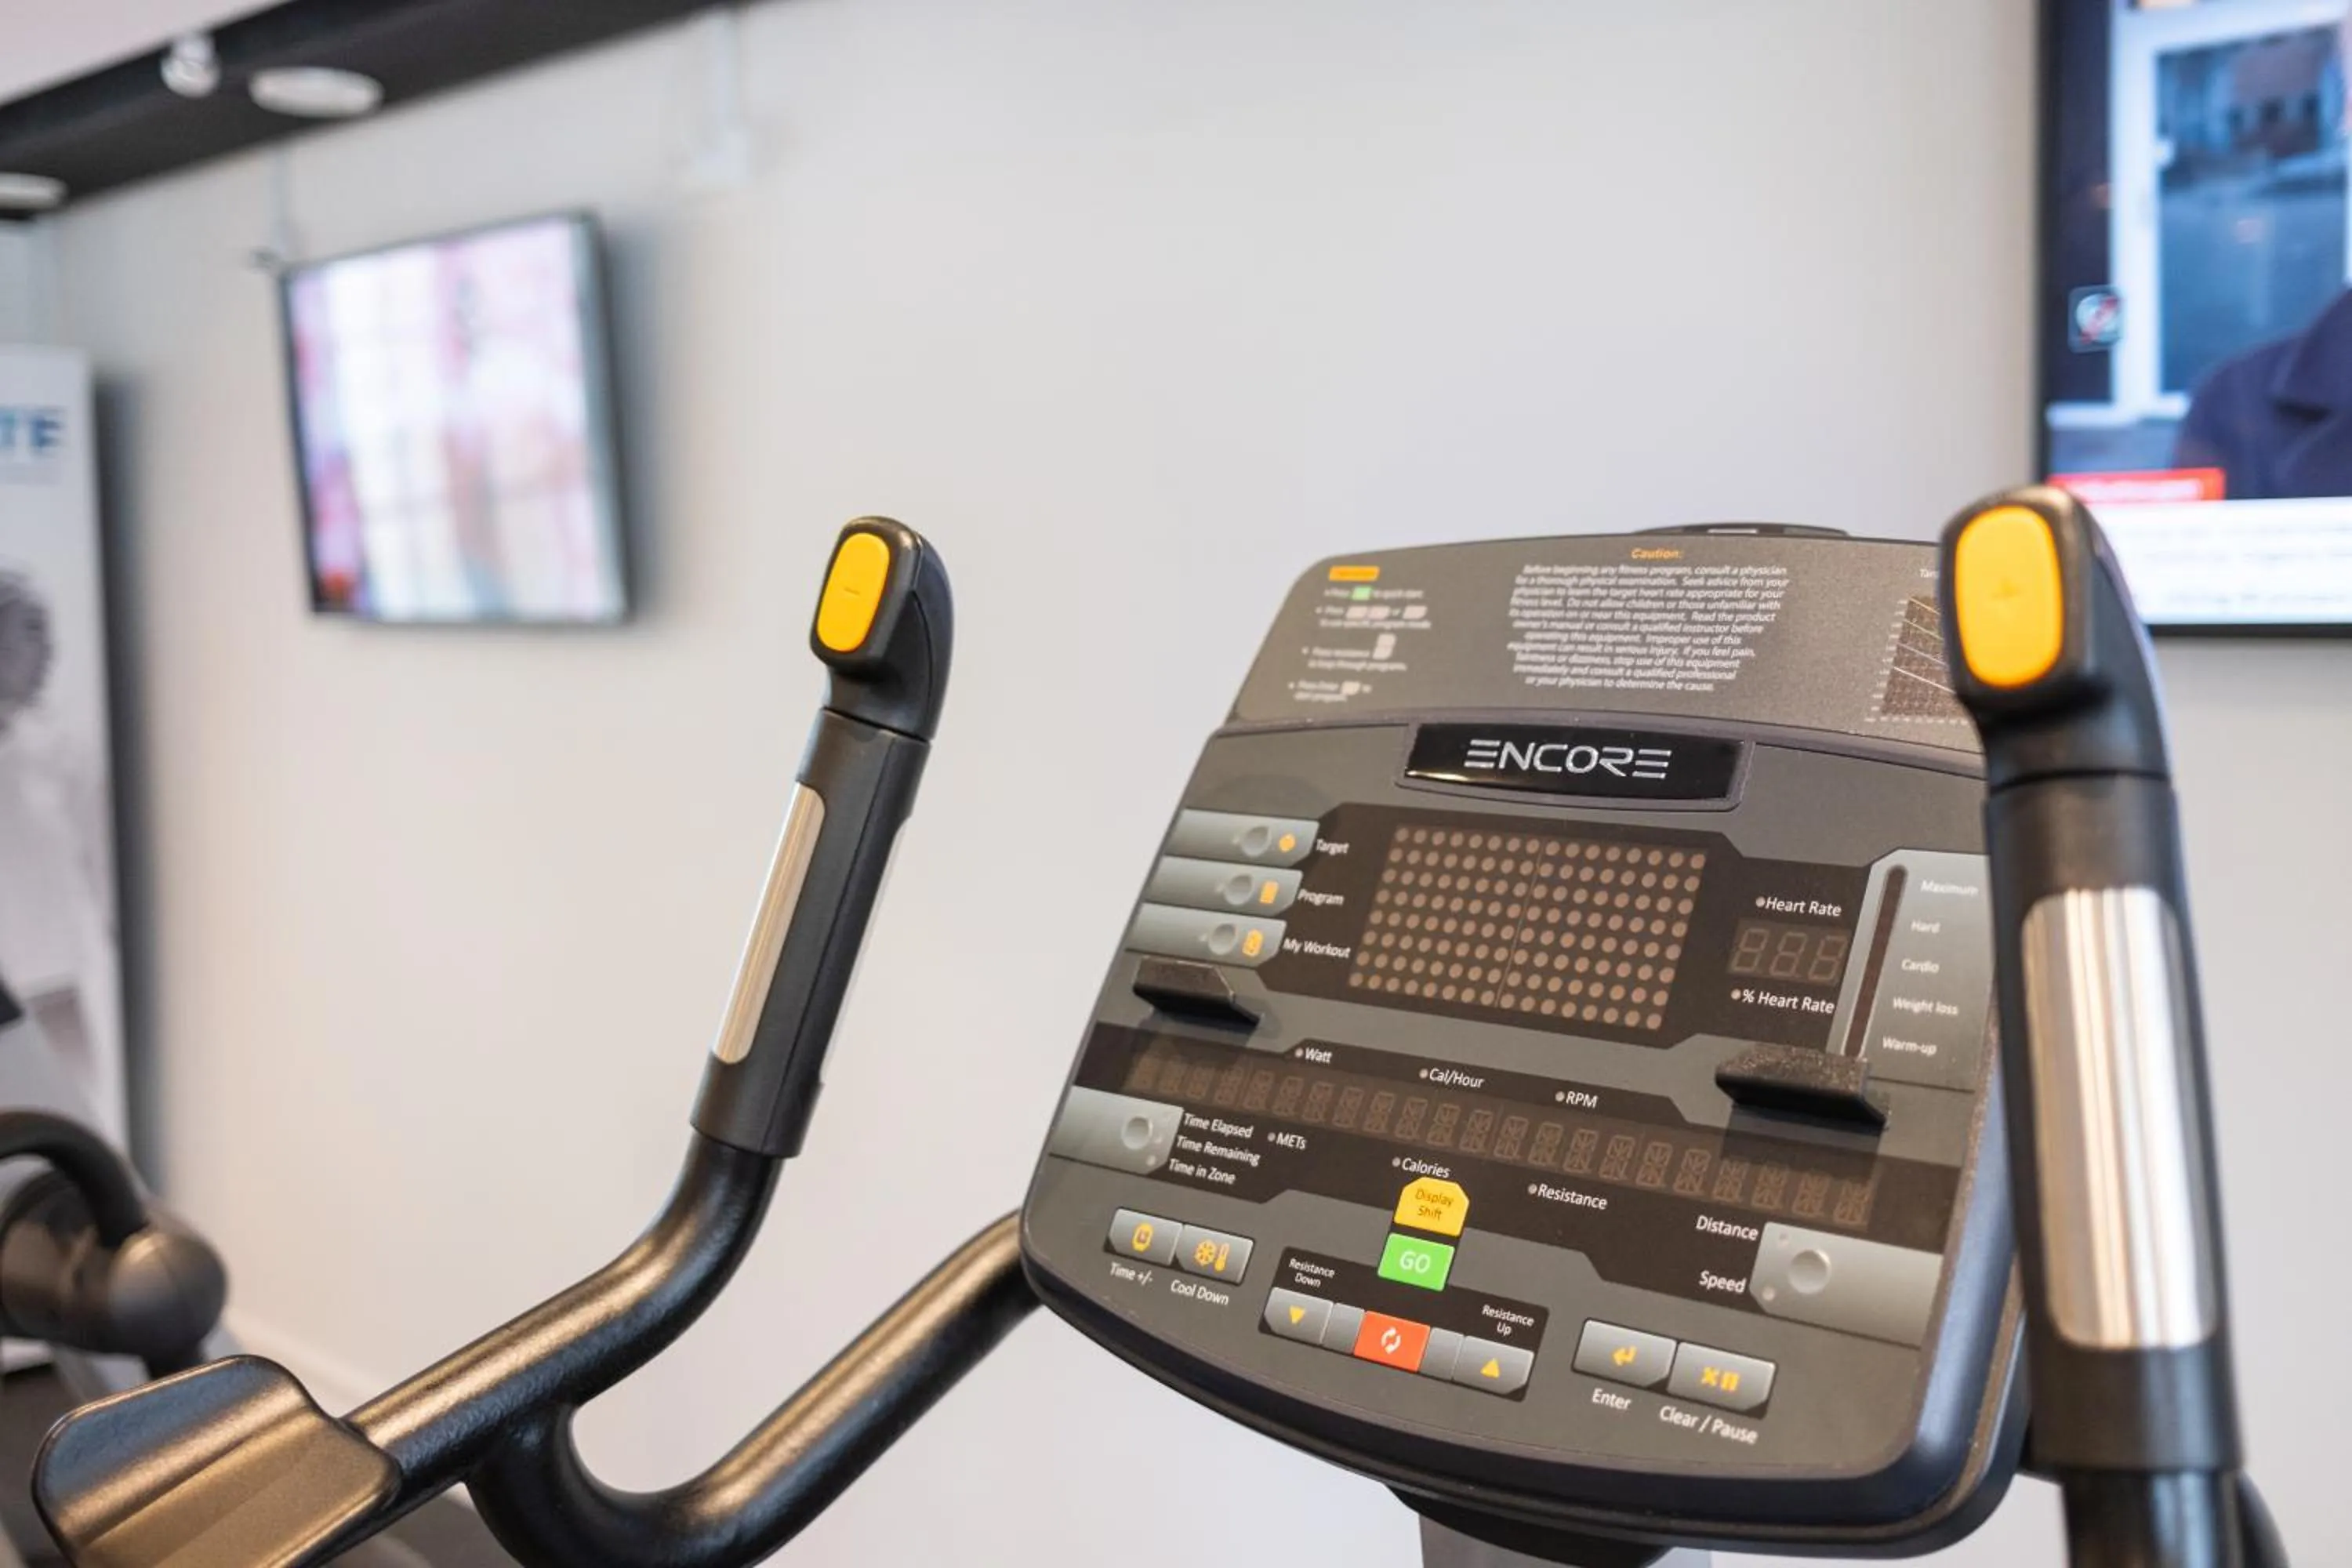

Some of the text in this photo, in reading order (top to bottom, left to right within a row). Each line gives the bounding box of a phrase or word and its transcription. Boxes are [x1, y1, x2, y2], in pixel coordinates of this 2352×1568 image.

[1632, 547, 1682, 560] Caution:
[1464, 739, 1672, 780] ENCORE
[1316, 838, 1349, 856] Target
[1298, 888, 1345, 906] Program
[1921, 880, 1980, 896] Maximum
[1766, 897, 1842, 917] Heart Rate
[1911, 920, 1942, 934] Hard
[1283, 938, 1351, 958] My Workout
[1901, 958, 1940, 974] Cardio
[1742, 989, 1836, 1014] % Heart Rate
[1893, 996, 1958, 1015] Weight loss
[1305, 1047, 1334, 1065] Watt
[1882, 1036, 1937, 1057] Warm-up
[1428, 1067, 1486, 1089] Cal/Hour
[1566, 1091, 1599, 1109] RPM
[1183, 1112, 1254, 1139] Time Elapsed
[1176, 1135, 1261, 1167] Time Remaining
[1276, 1131, 1308, 1151] METs
[1168, 1158, 1238, 1185] Time in Zone
[1401, 1156, 1451, 1178] Calories
[1415, 1188, 1454, 1207] Display
[1537, 1183, 1608, 1210] Resistance
[1417, 1205, 1443, 1221] Shift
[1696, 1214, 1760, 1242] Distance
[1109, 1261, 1136, 1281] Time
[1288, 1258, 1335, 1278] Resistance
[1399, 1250, 1432, 1274] GO
[1294, 1272, 1321, 1288] Down
[1699, 1269, 1748, 1294] Speed
[1170, 1279, 1230, 1306] Cool Down
[1482, 1304, 1534, 1327] Resistance
[1496, 1322, 1513, 1338] Up
[1591, 1388, 1632, 1410] Enter
[1659, 1405, 1759, 1445] Clear / Pause
